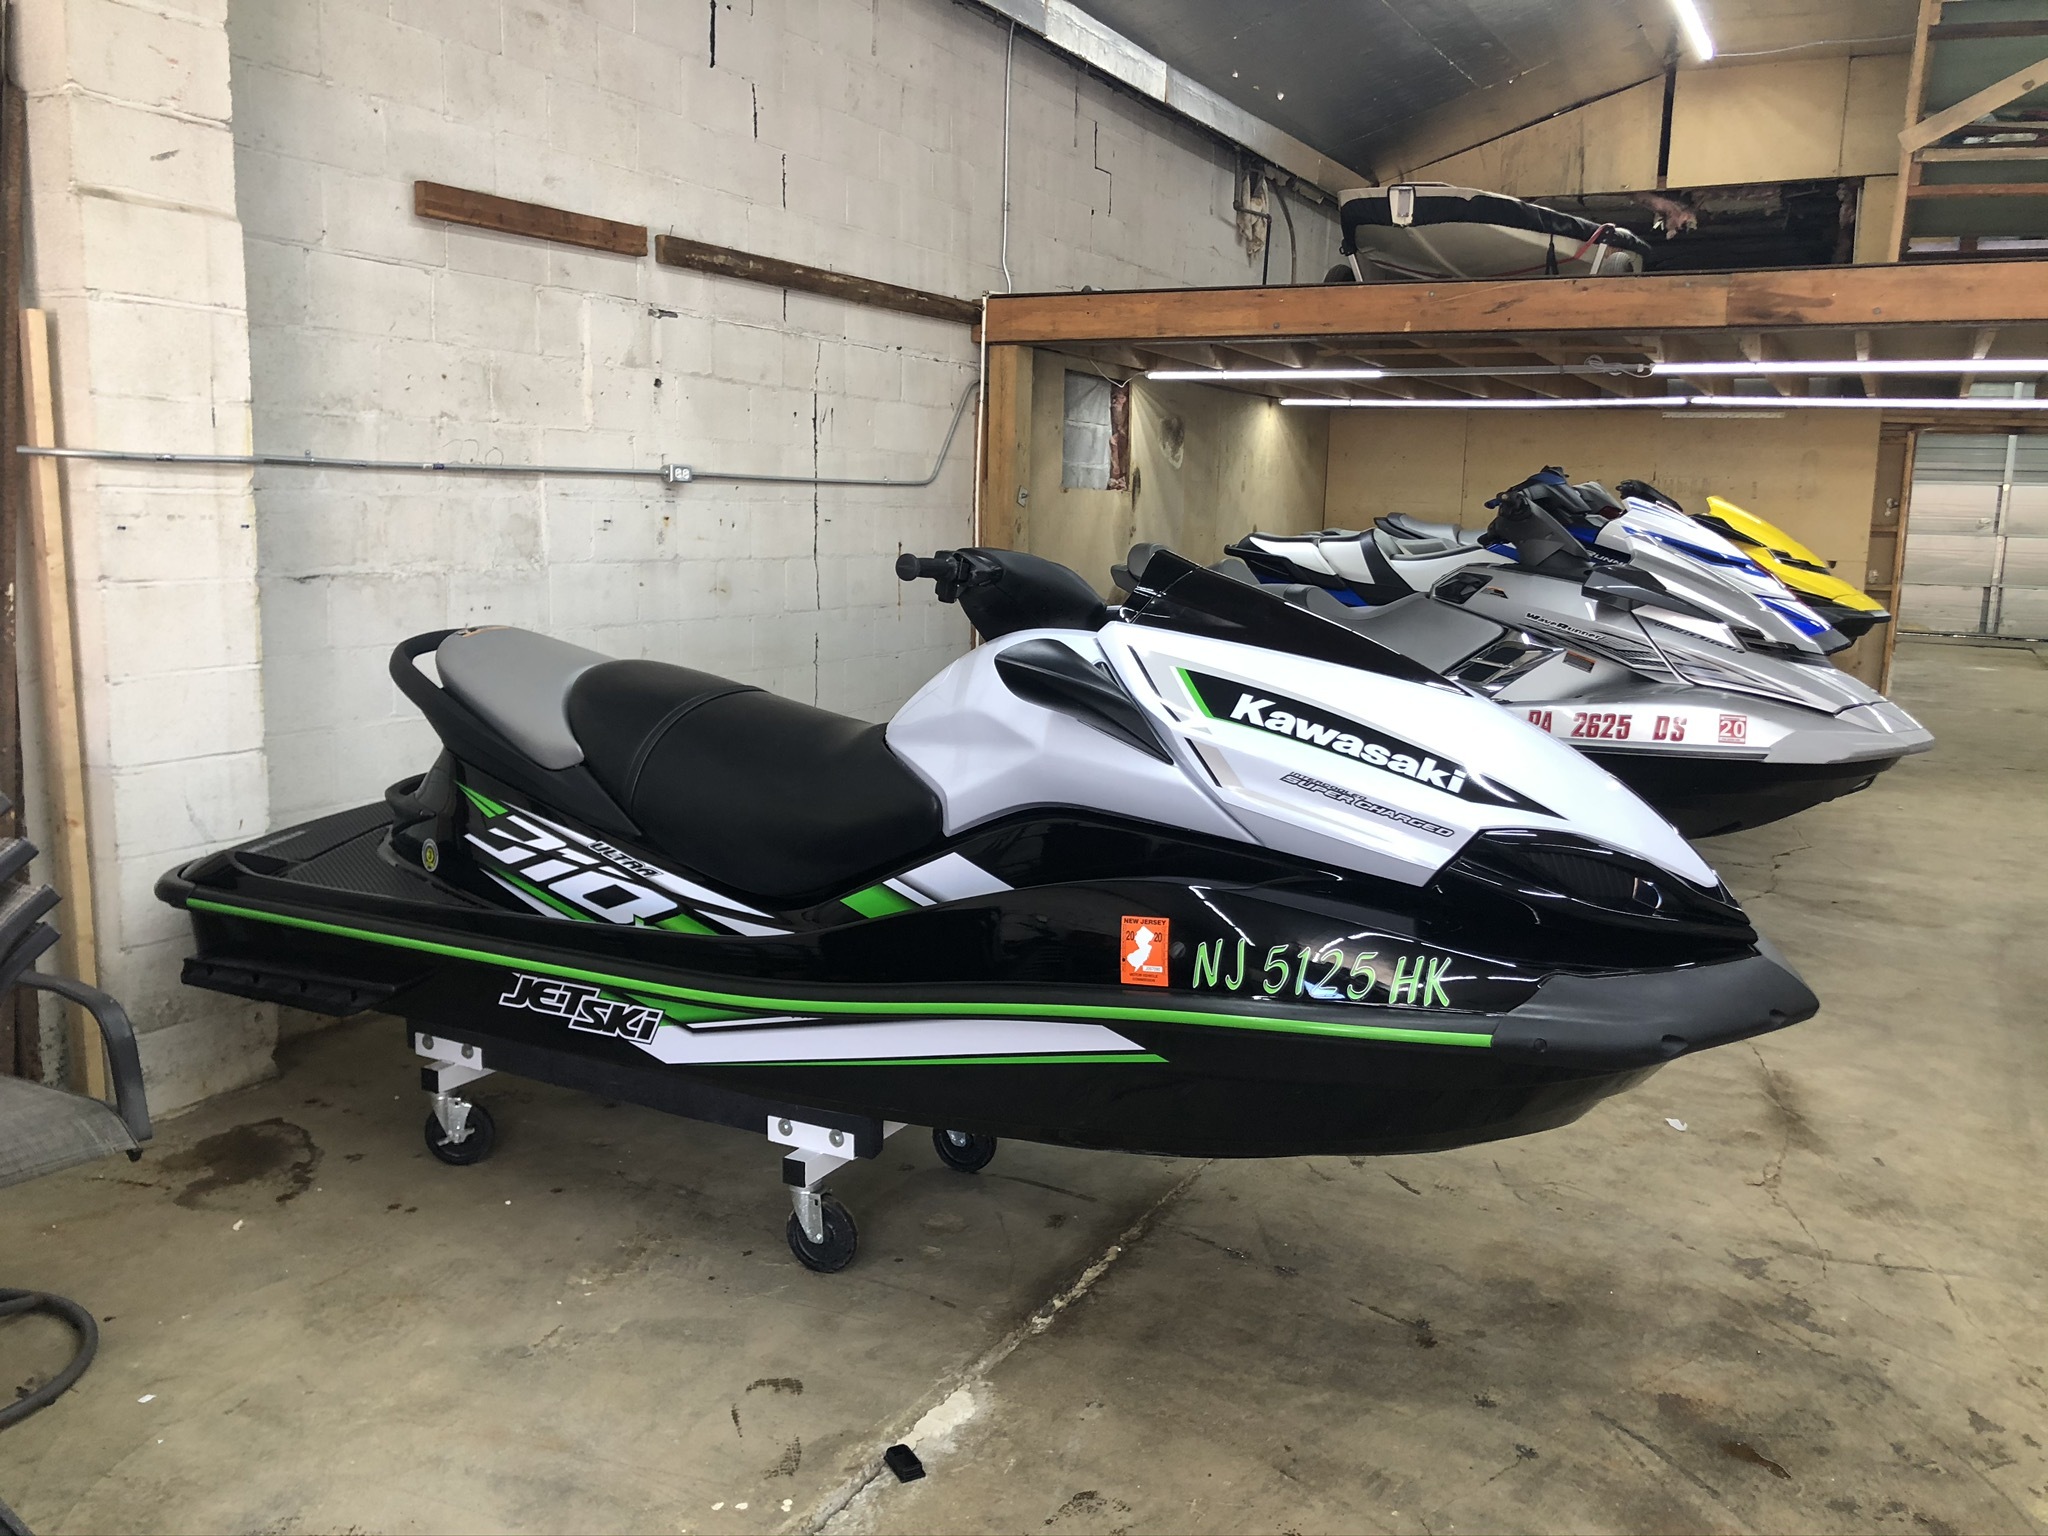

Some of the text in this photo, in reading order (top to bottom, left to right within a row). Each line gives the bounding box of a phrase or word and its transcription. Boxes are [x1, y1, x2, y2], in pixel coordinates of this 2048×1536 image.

[1525, 612, 1603, 641] WaveRunner
[1571, 712, 1632, 740] 2625
[1652, 715, 1688, 743] DS
[1719, 720, 1746, 738] 20
[1230, 694, 1469, 795] Kawasaki
[588, 840, 663, 878] ULTRA
[1124, 917, 1167, 926] NEW JERSEY
[1126, 930, 1163, 943] 20 20
[1192, 938, 1452, 1007] NJ 5125 HK
